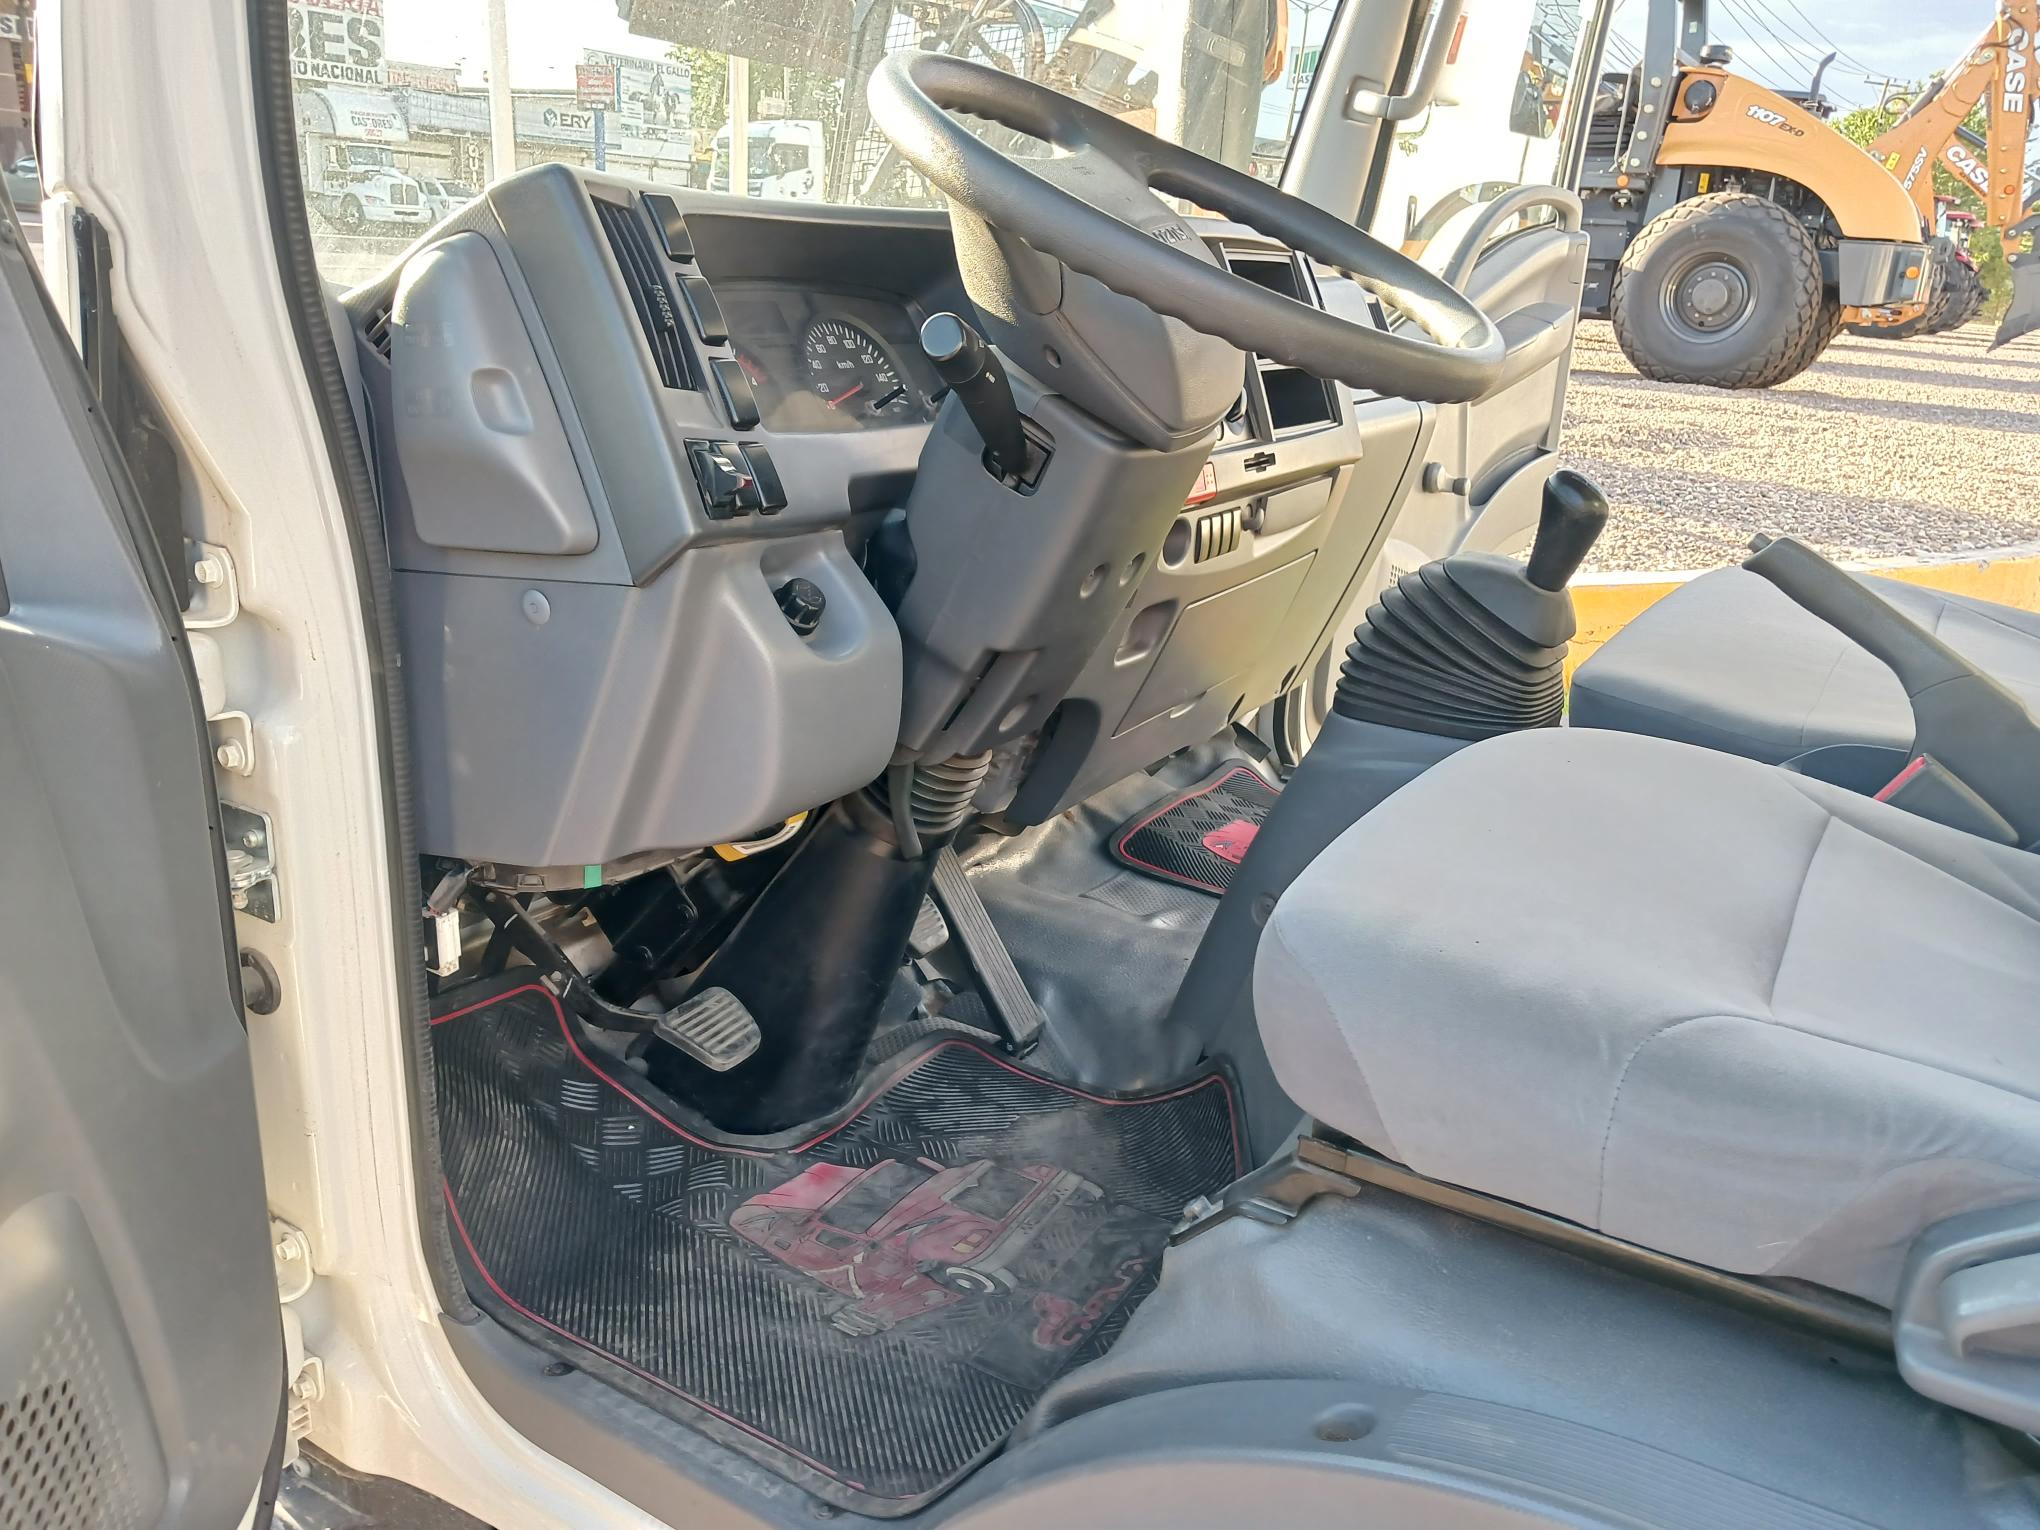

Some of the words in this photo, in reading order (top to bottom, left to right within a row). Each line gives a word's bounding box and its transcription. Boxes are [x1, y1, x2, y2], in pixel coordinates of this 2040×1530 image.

[310, 62, 383, 85] NACIONAL
[656, 62, 665, 75] EL
[666, 65, 690, 78] GALLO
[2003, 28, 2030, 113] CASE
[560, 113, 592, 129] ERY
[1746, 104, 1787, 126] 1107
[836, 360, 855, 369] km/h
